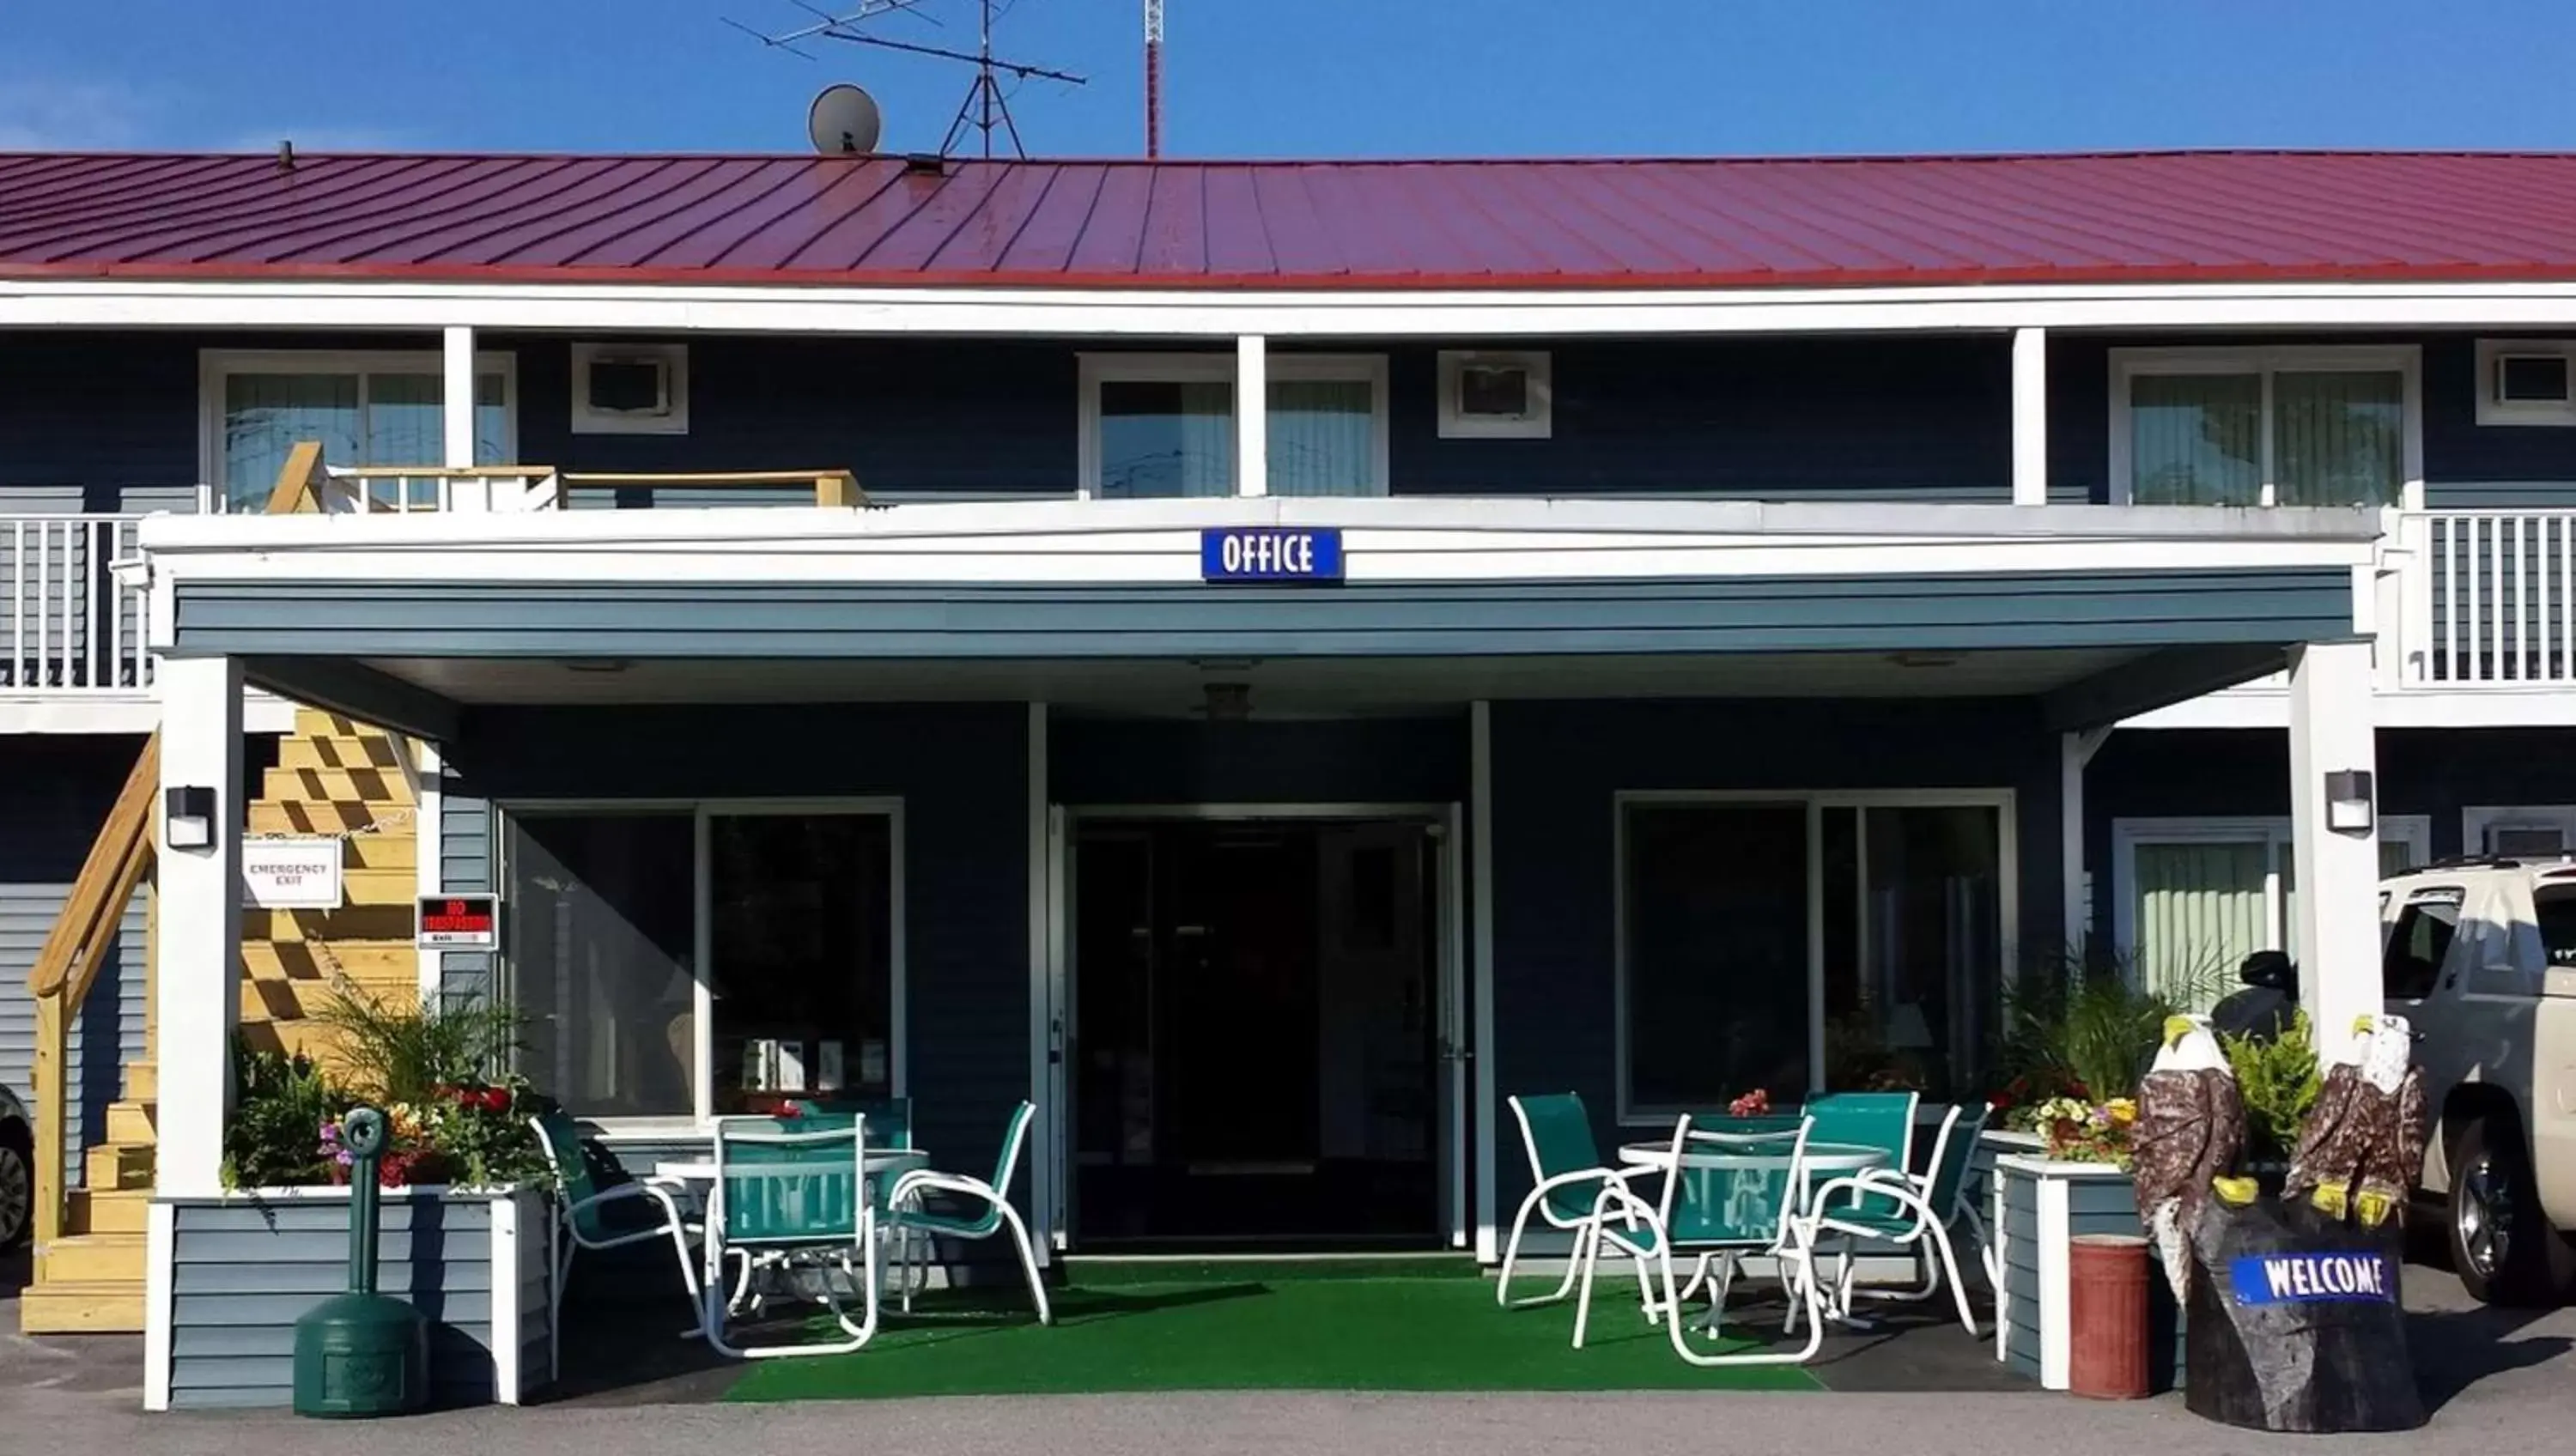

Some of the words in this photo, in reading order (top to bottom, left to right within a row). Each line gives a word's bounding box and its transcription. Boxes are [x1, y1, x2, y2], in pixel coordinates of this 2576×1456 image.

[1222, 534, 1313, 573] OFFICE
[250, 864, 326, 874] EMERGENCY
[276, 876, 302, 885] EXIT
[447, 901, 466, 915] NO
[2264, 1256, 2384, 1298] WELCOME
